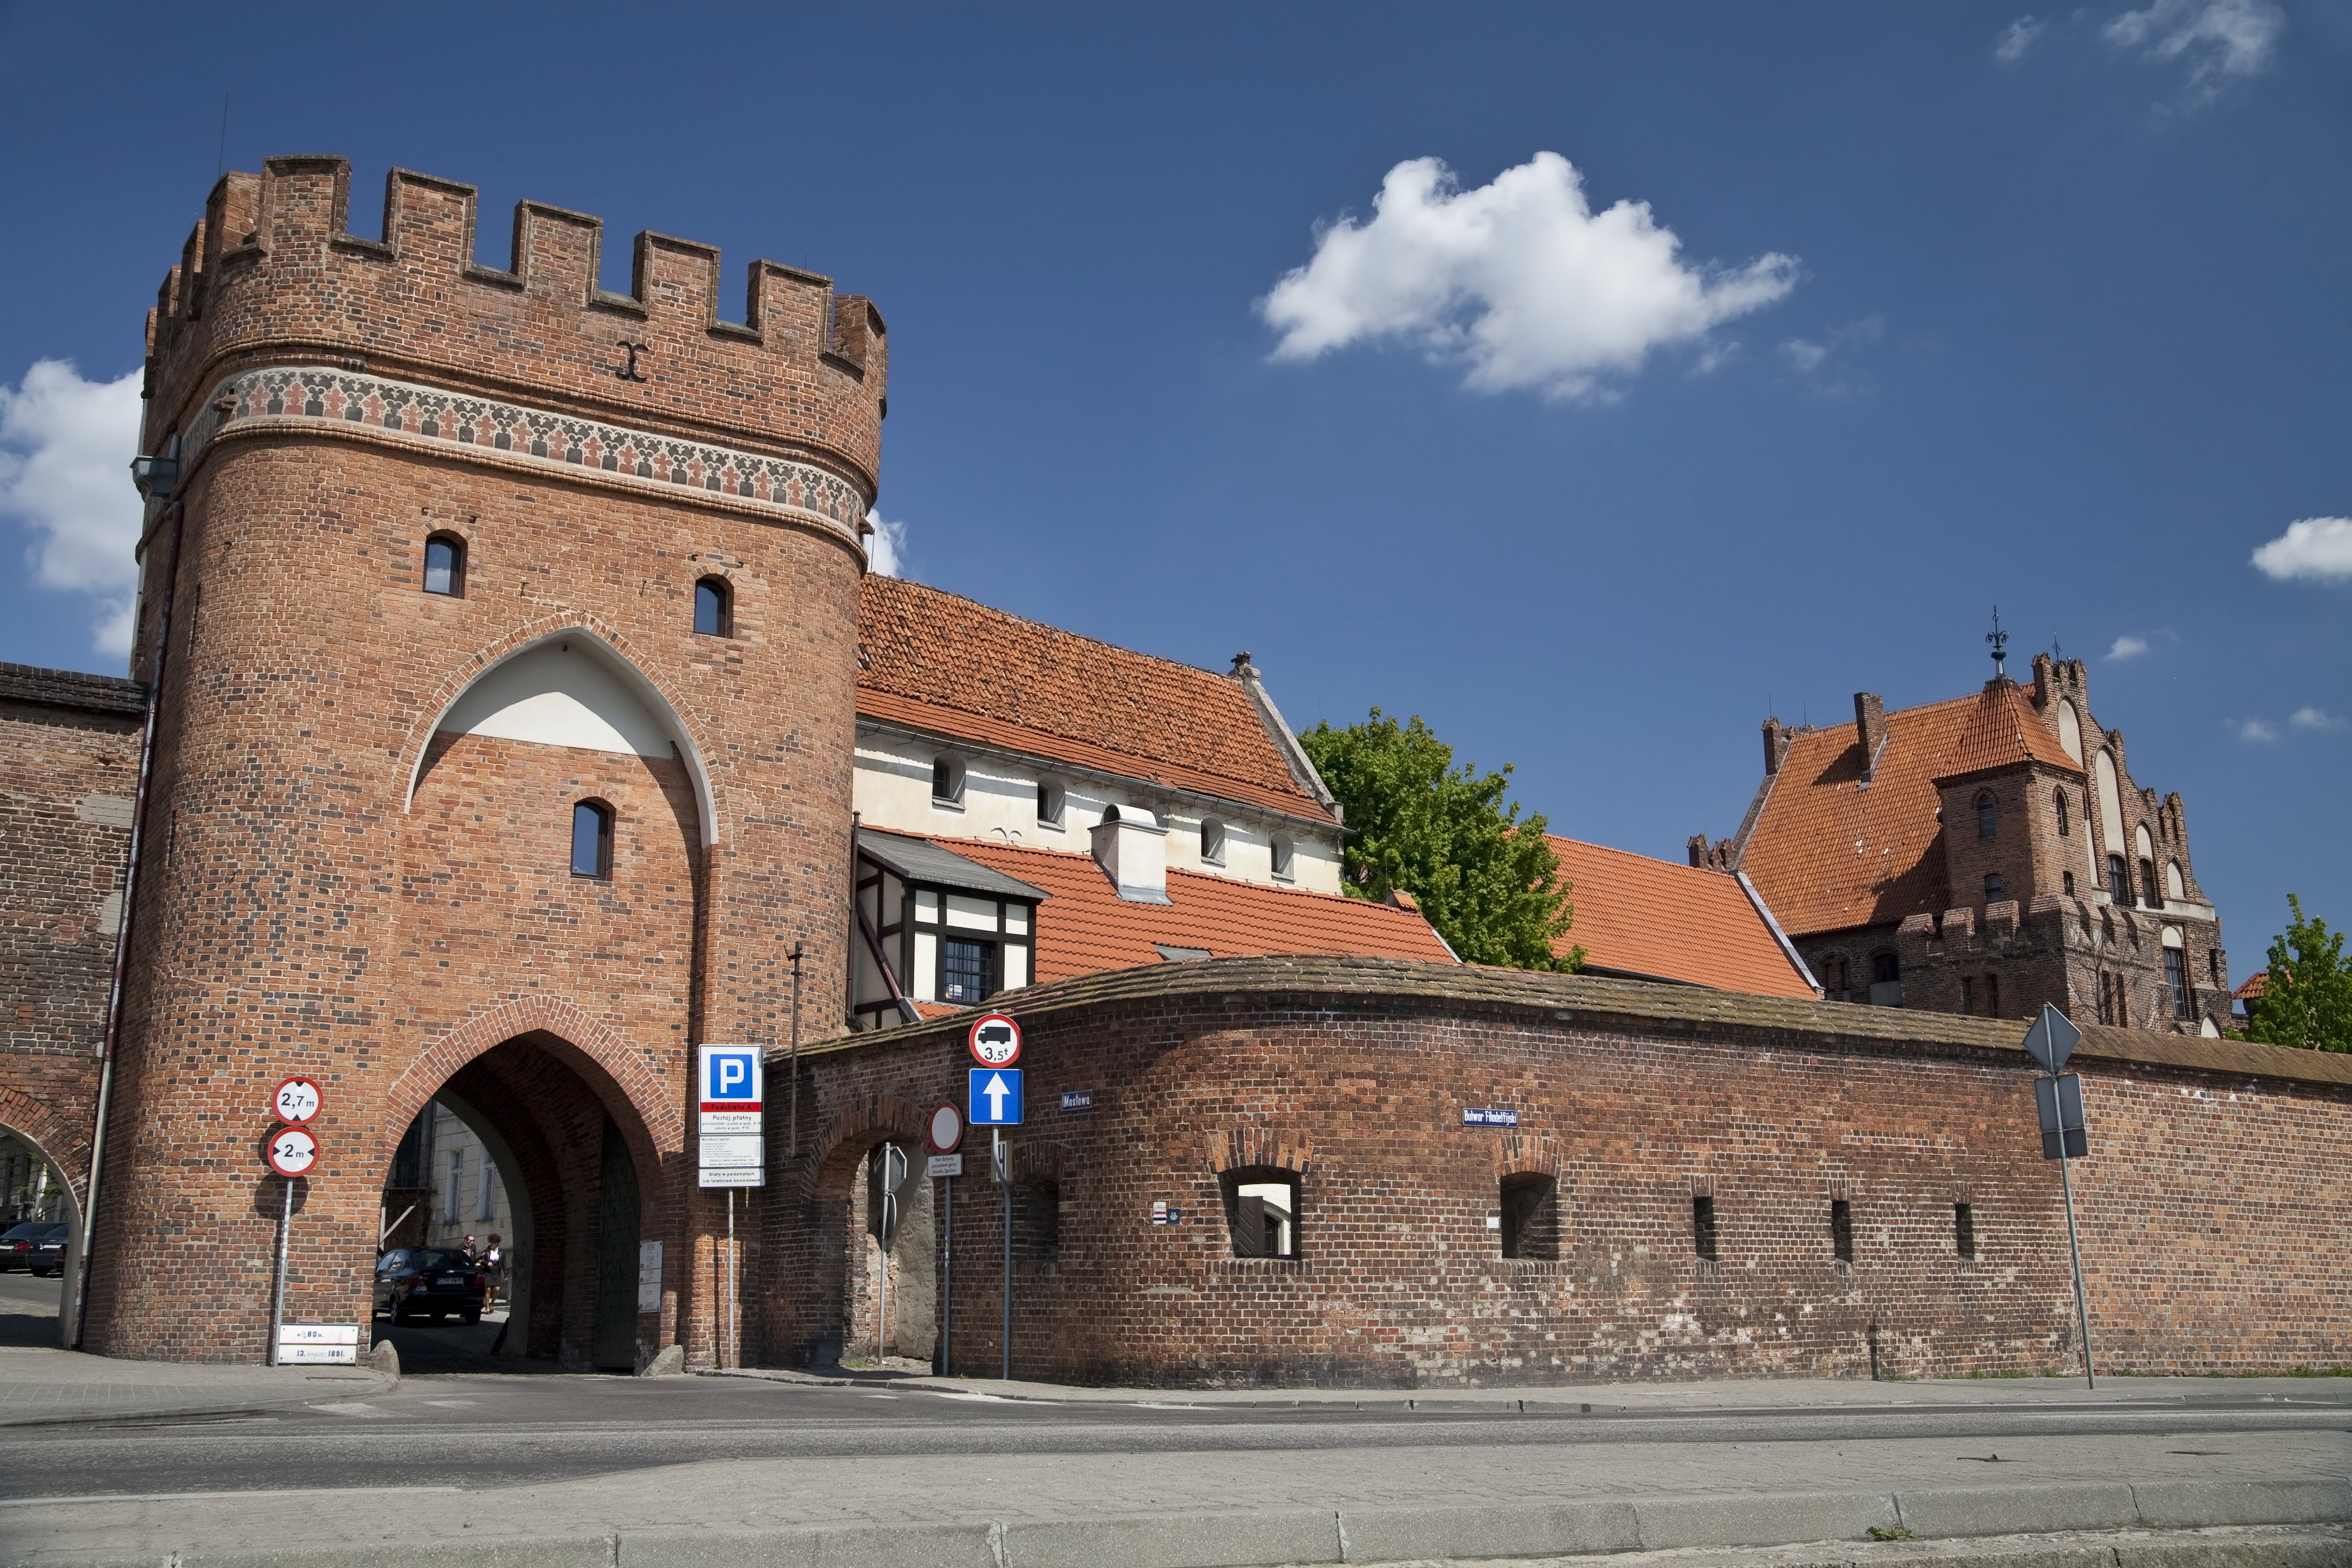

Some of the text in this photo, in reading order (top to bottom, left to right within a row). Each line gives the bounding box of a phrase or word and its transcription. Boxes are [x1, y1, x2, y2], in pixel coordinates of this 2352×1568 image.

[720, 1059, 744, 1093] P
[281, 1093, 304, 1109] 2,7
[1065, 1094, 1089, 1107] Mostowa
[1464, 1110, 1516, 1125] Bulwar Filadelfijski
[284, 1144, 293, 1157] 2
